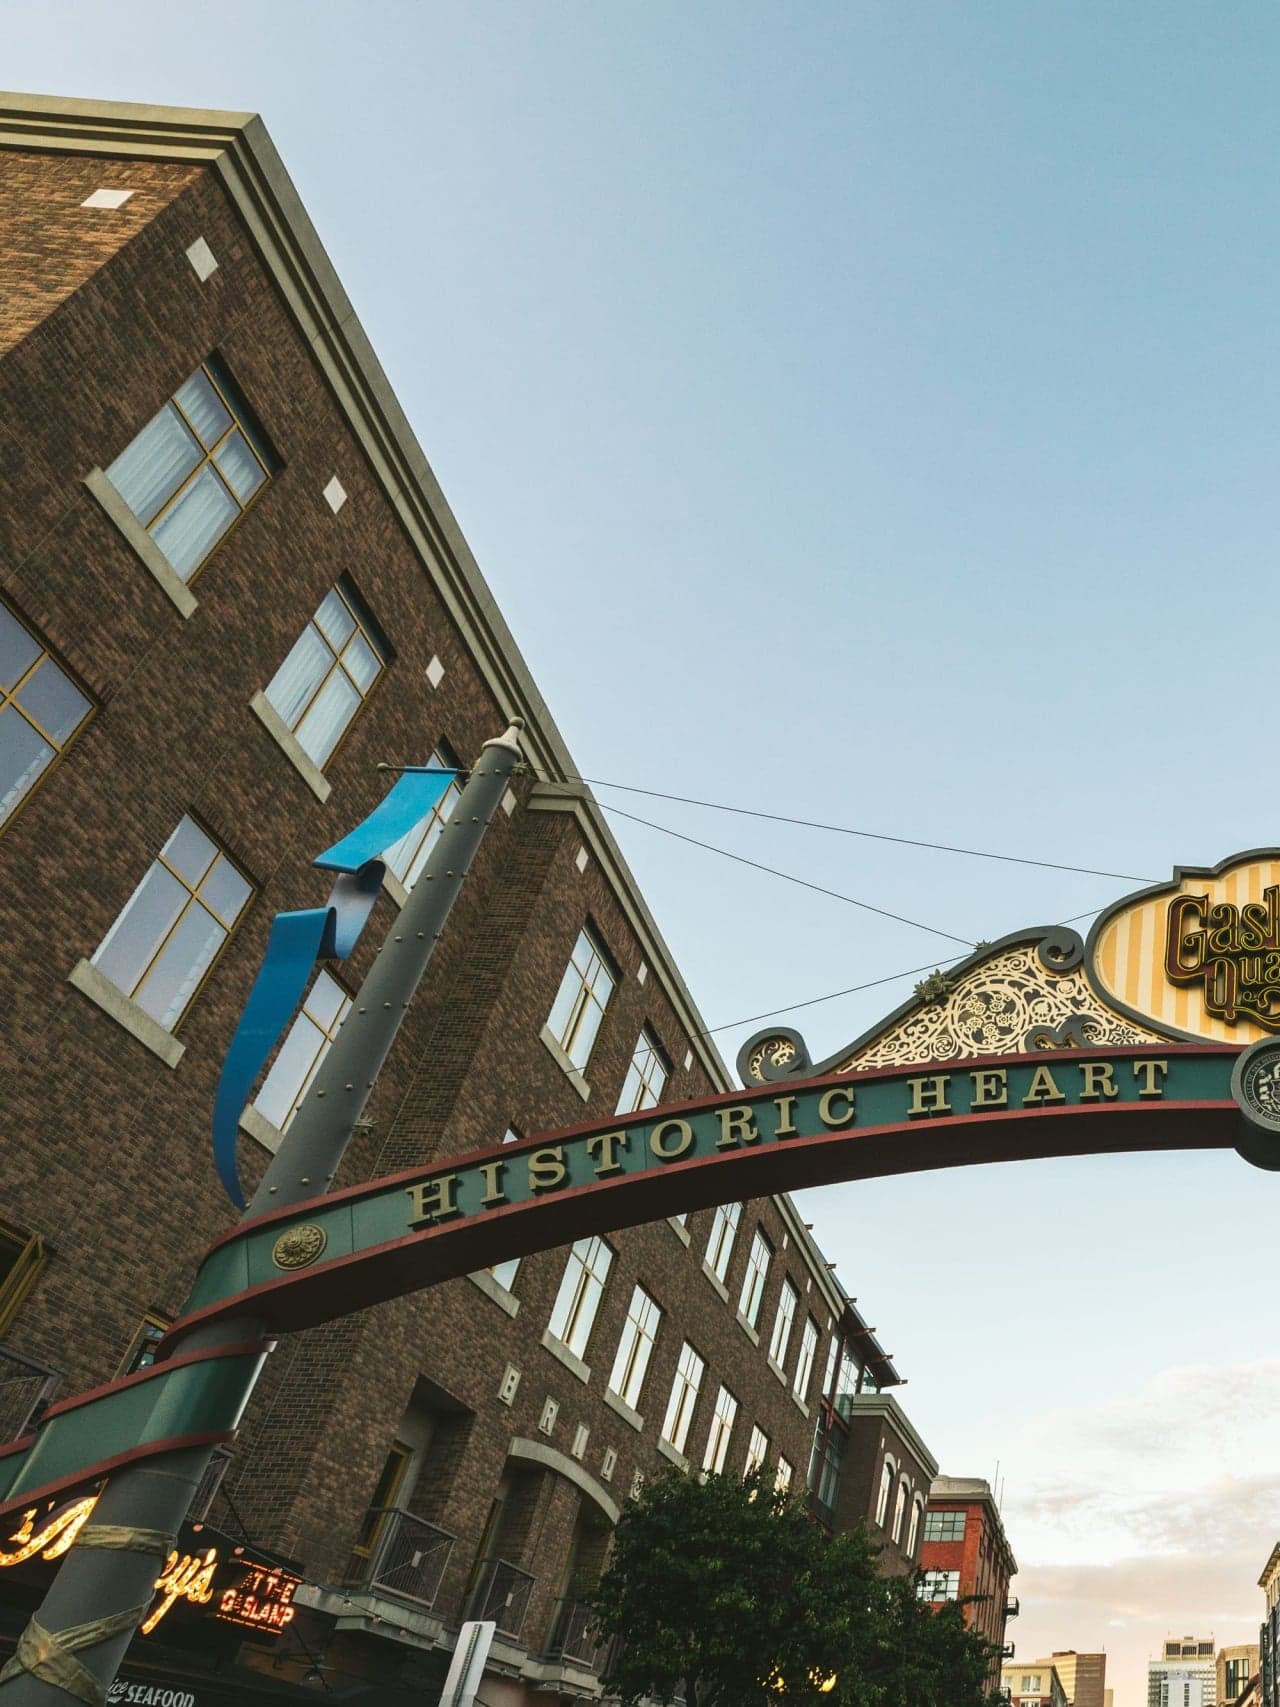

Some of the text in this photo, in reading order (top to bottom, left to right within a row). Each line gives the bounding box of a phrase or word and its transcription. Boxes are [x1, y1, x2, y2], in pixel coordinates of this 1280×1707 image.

[404, 1085, 856, 1229] HISTORIC
[906, 1060, 1169, 1117] HEART
[125, 1684, 195, 1707] SEAFOOD
